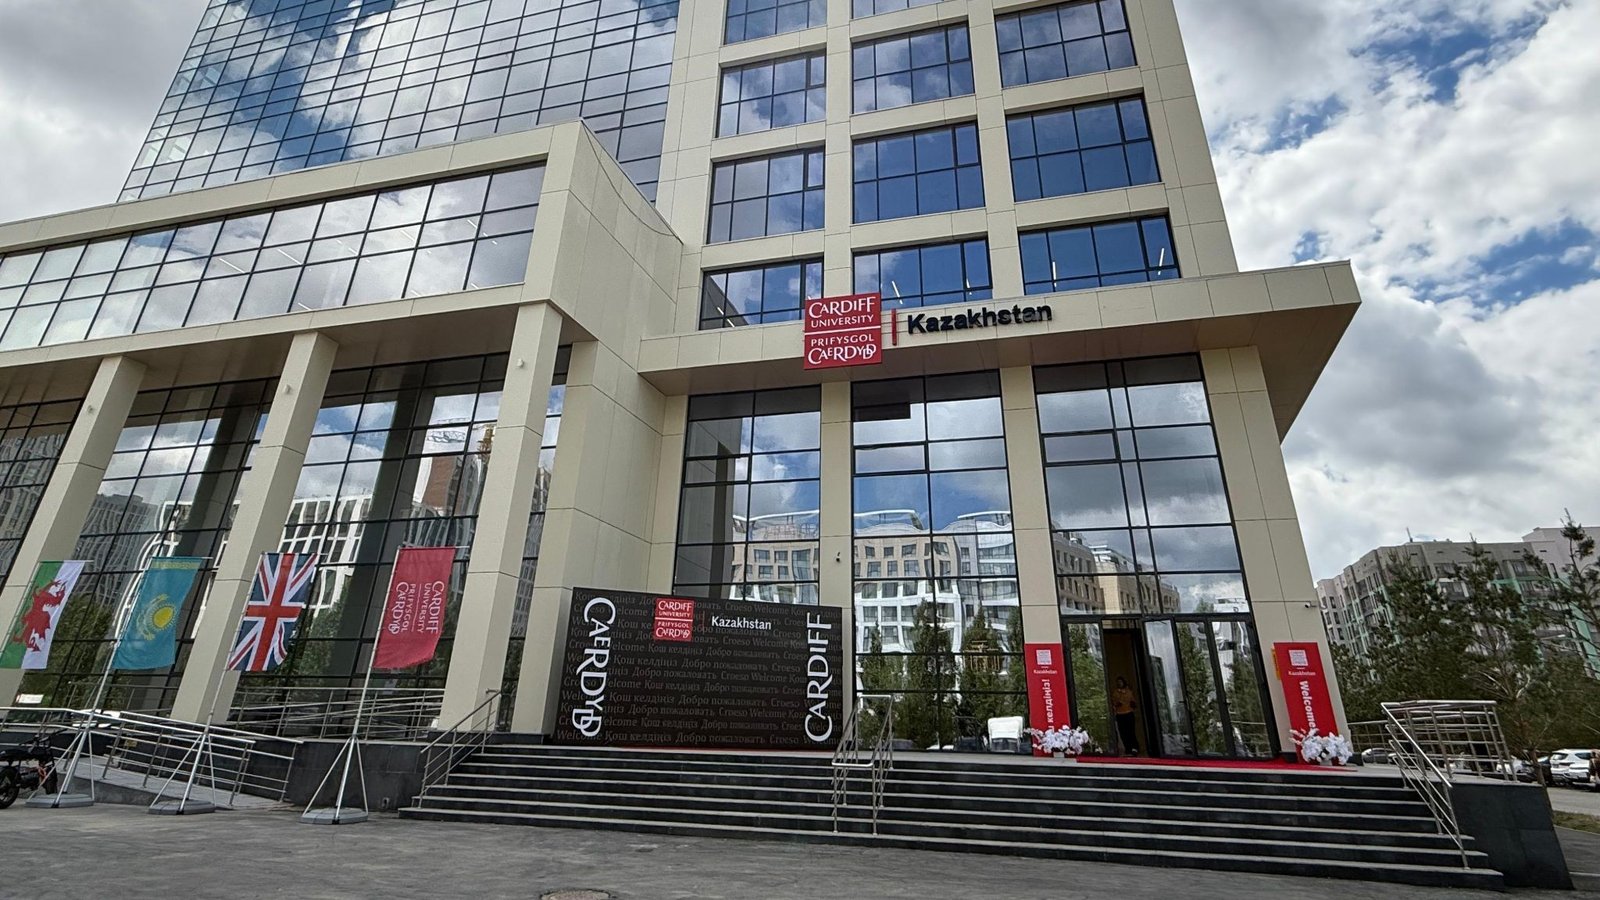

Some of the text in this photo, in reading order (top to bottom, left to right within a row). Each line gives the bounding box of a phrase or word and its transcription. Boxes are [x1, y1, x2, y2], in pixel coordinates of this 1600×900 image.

[808, 296, 876, 318] CARDIFF
[810, 314, 874, 328] UNIVERSITY
[907, 304, 1053, 334] Kazakhstan
[810, 334, 874, 347] PRIFYSGOL
[401, 583, 416, 633] PRIFYSGOL
[417, 582, 432, 633] UNIVERSITY
[426, 581, 445, 635] CARDIFF
[658, 600, 692, 612] CARDIFF
[711, 615, 772, 630] Kazakhstan
[804, 612, 833, 742] CARDIFF
[1299, 680, 1317, 728] Welcome
